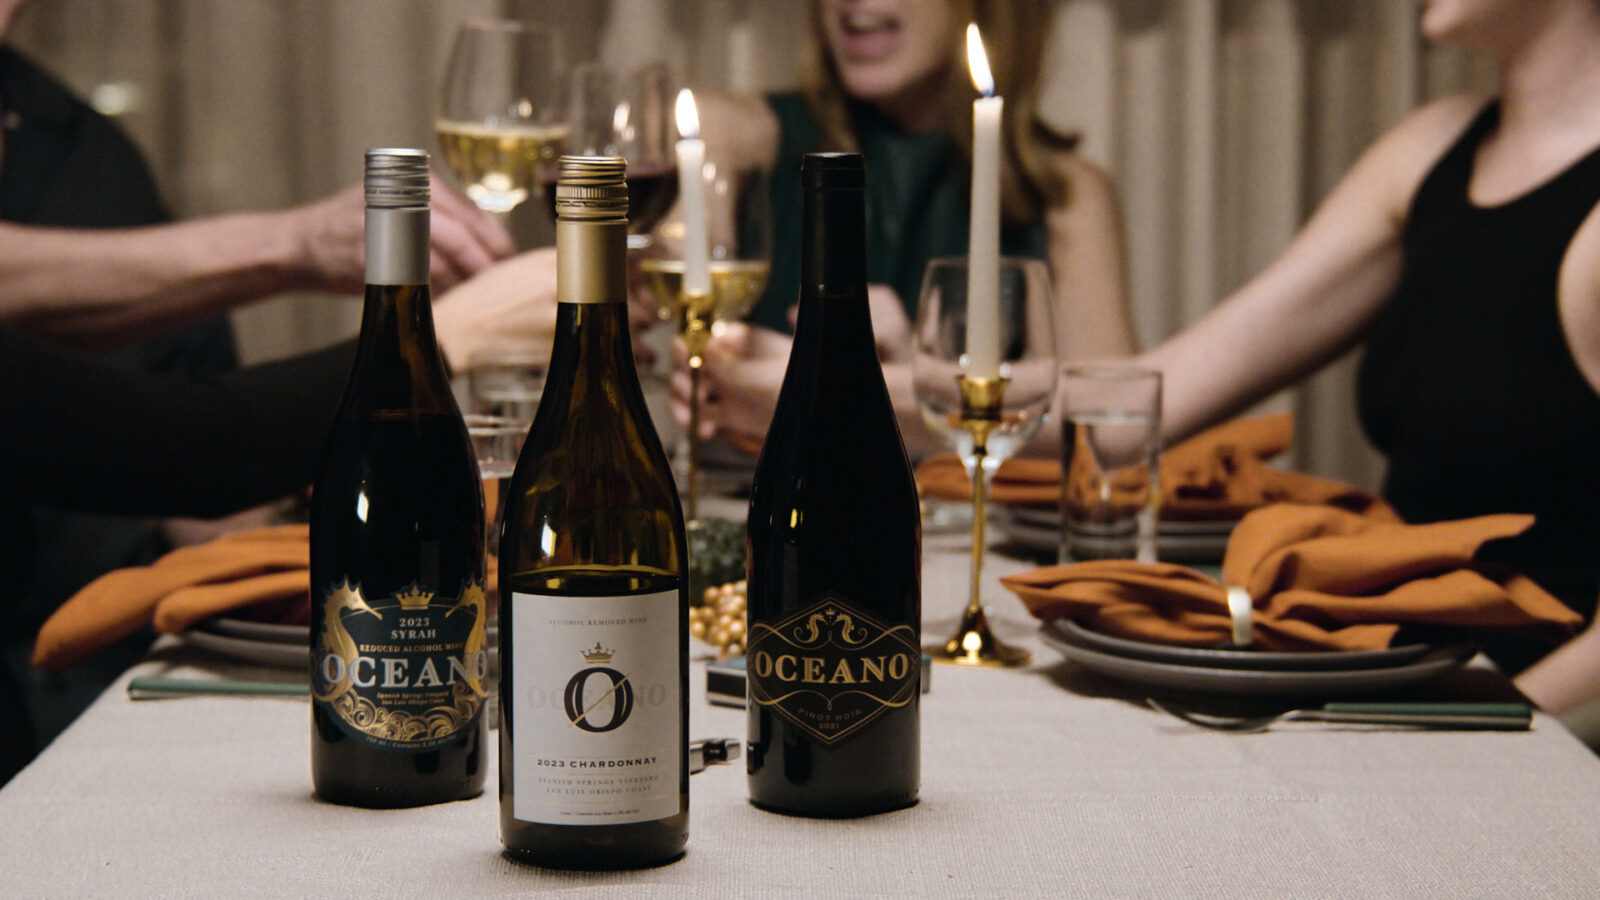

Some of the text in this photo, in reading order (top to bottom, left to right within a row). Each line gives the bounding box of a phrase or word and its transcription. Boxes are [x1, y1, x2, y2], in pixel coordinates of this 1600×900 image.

[399, 617, 431, 628] 2023
[548, 616, 648, 626] ALCOHOL REMOVED WINE
[391, 629, 437, 640] SYRAH
[359, 643, 400, 653] REDUCED
[402, 643, 443, 652] ALCOHOL
[322, 649, 487, 689] OCEANO
[754, 650, 909, 684] OCEANO
[799, 707, 863, 722] PINOT NOIR
[536, 756, 658, 769] 2023 CHARDONNAY
[538, 777, 573, 786] SPANISH
[576, 778, 615, 786] SPRINGS
[546, 785, 652, 796] SAN LUIS OBISPO COAST
